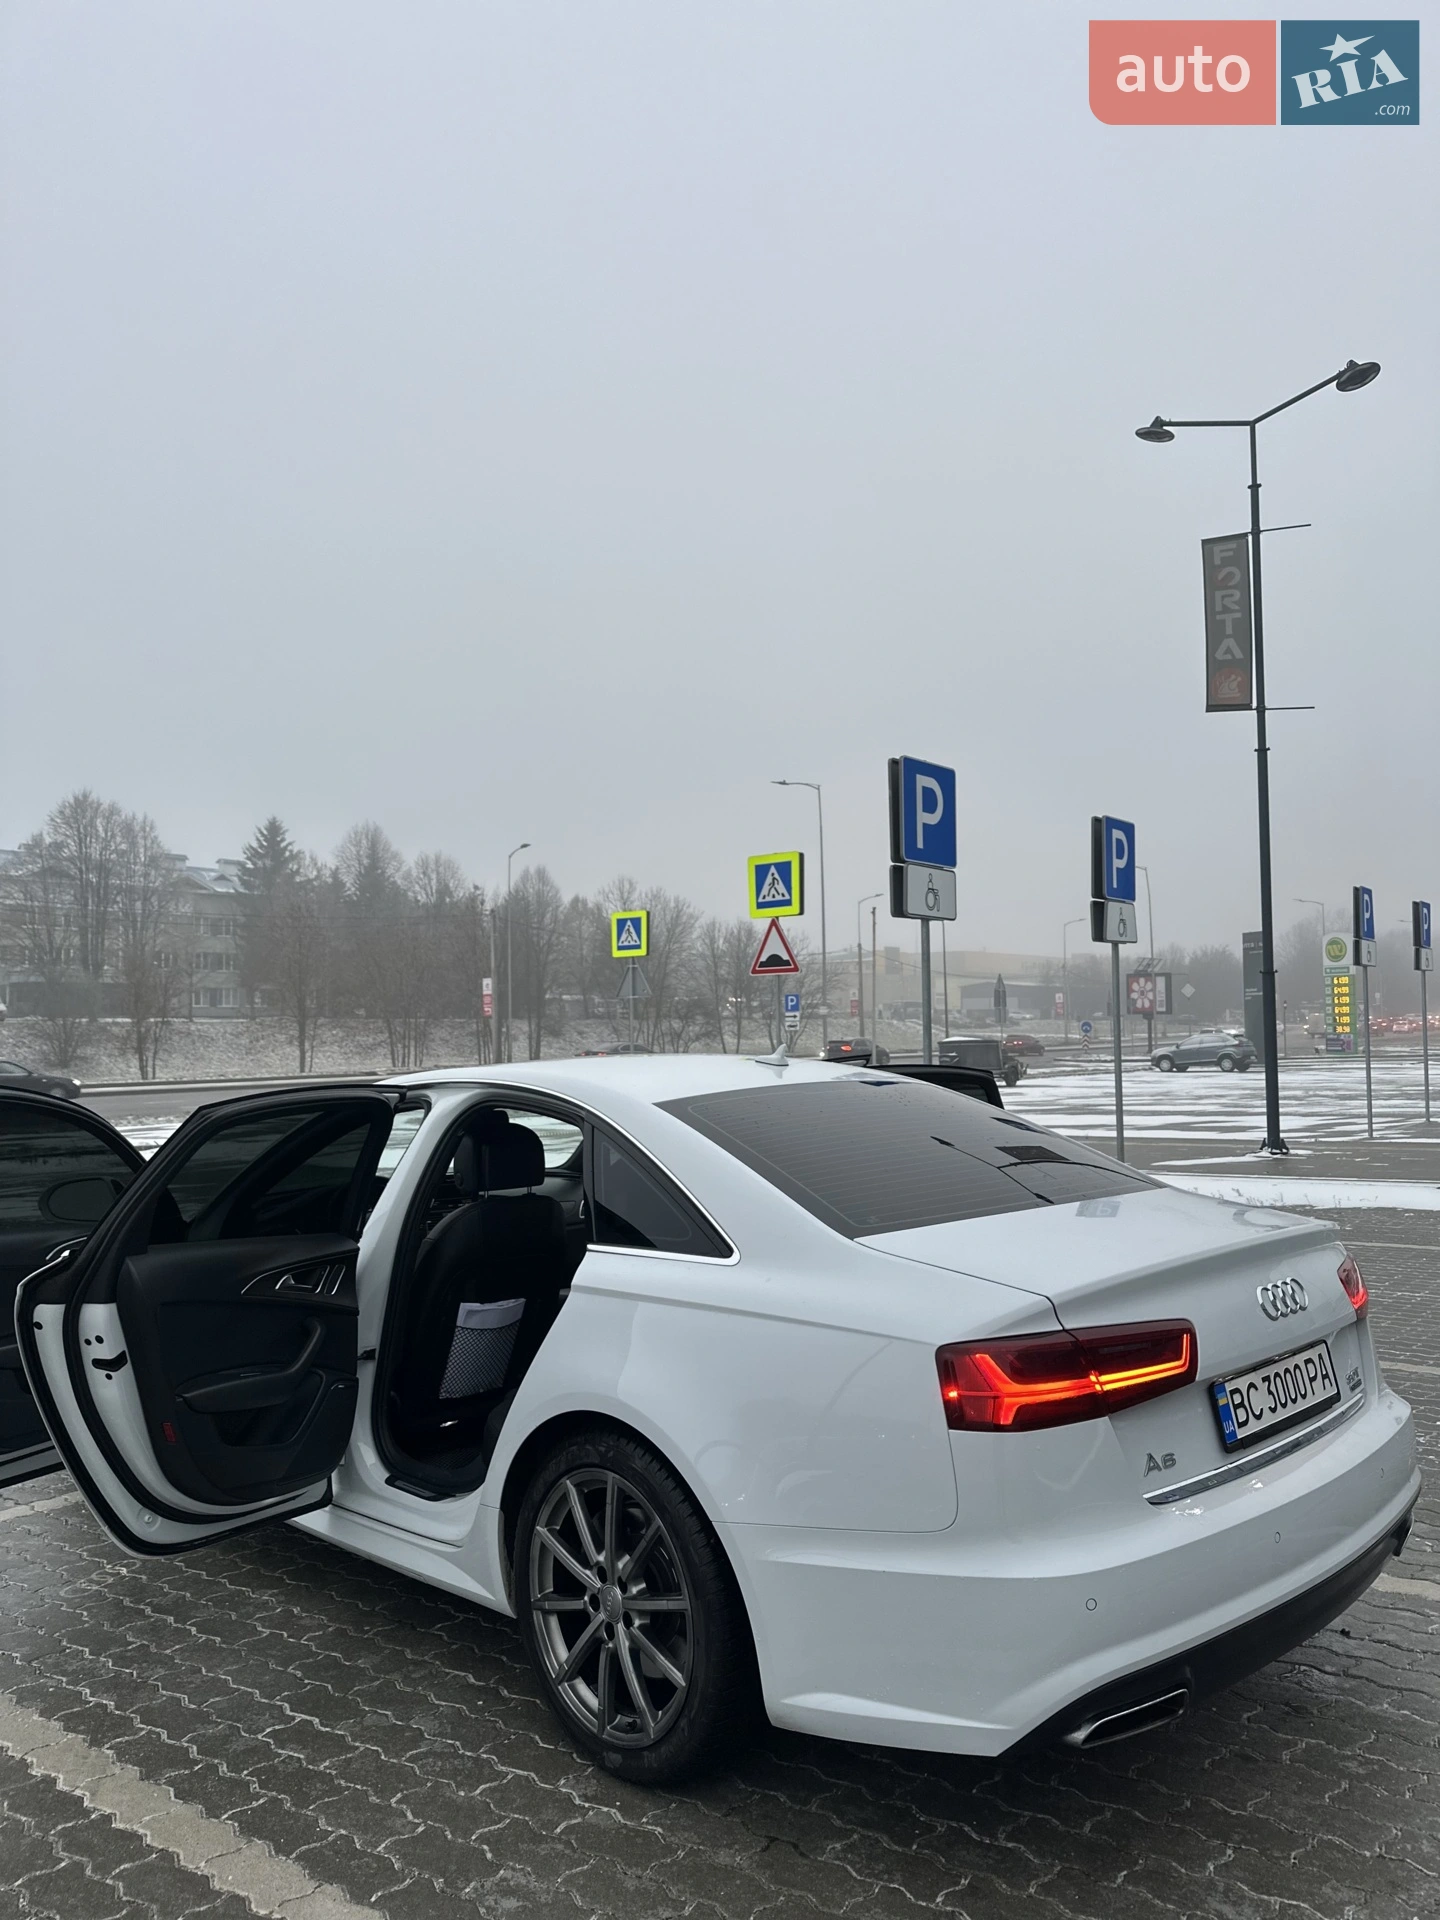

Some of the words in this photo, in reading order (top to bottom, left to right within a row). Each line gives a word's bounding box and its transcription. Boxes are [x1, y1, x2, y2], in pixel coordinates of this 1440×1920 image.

[1213, 543, 1244, 660] FORTA
[915, 773, 944, 849] P
[1111, 828, 1129, 888] P
[1363, 893, 1371, 932] P
[1422, 907, 1429, 940] P
[787, 996, 797, 1010] P
[1223, 1421, 1235, 1434] UA
[1143, 1452, 1177, 1478] A6
